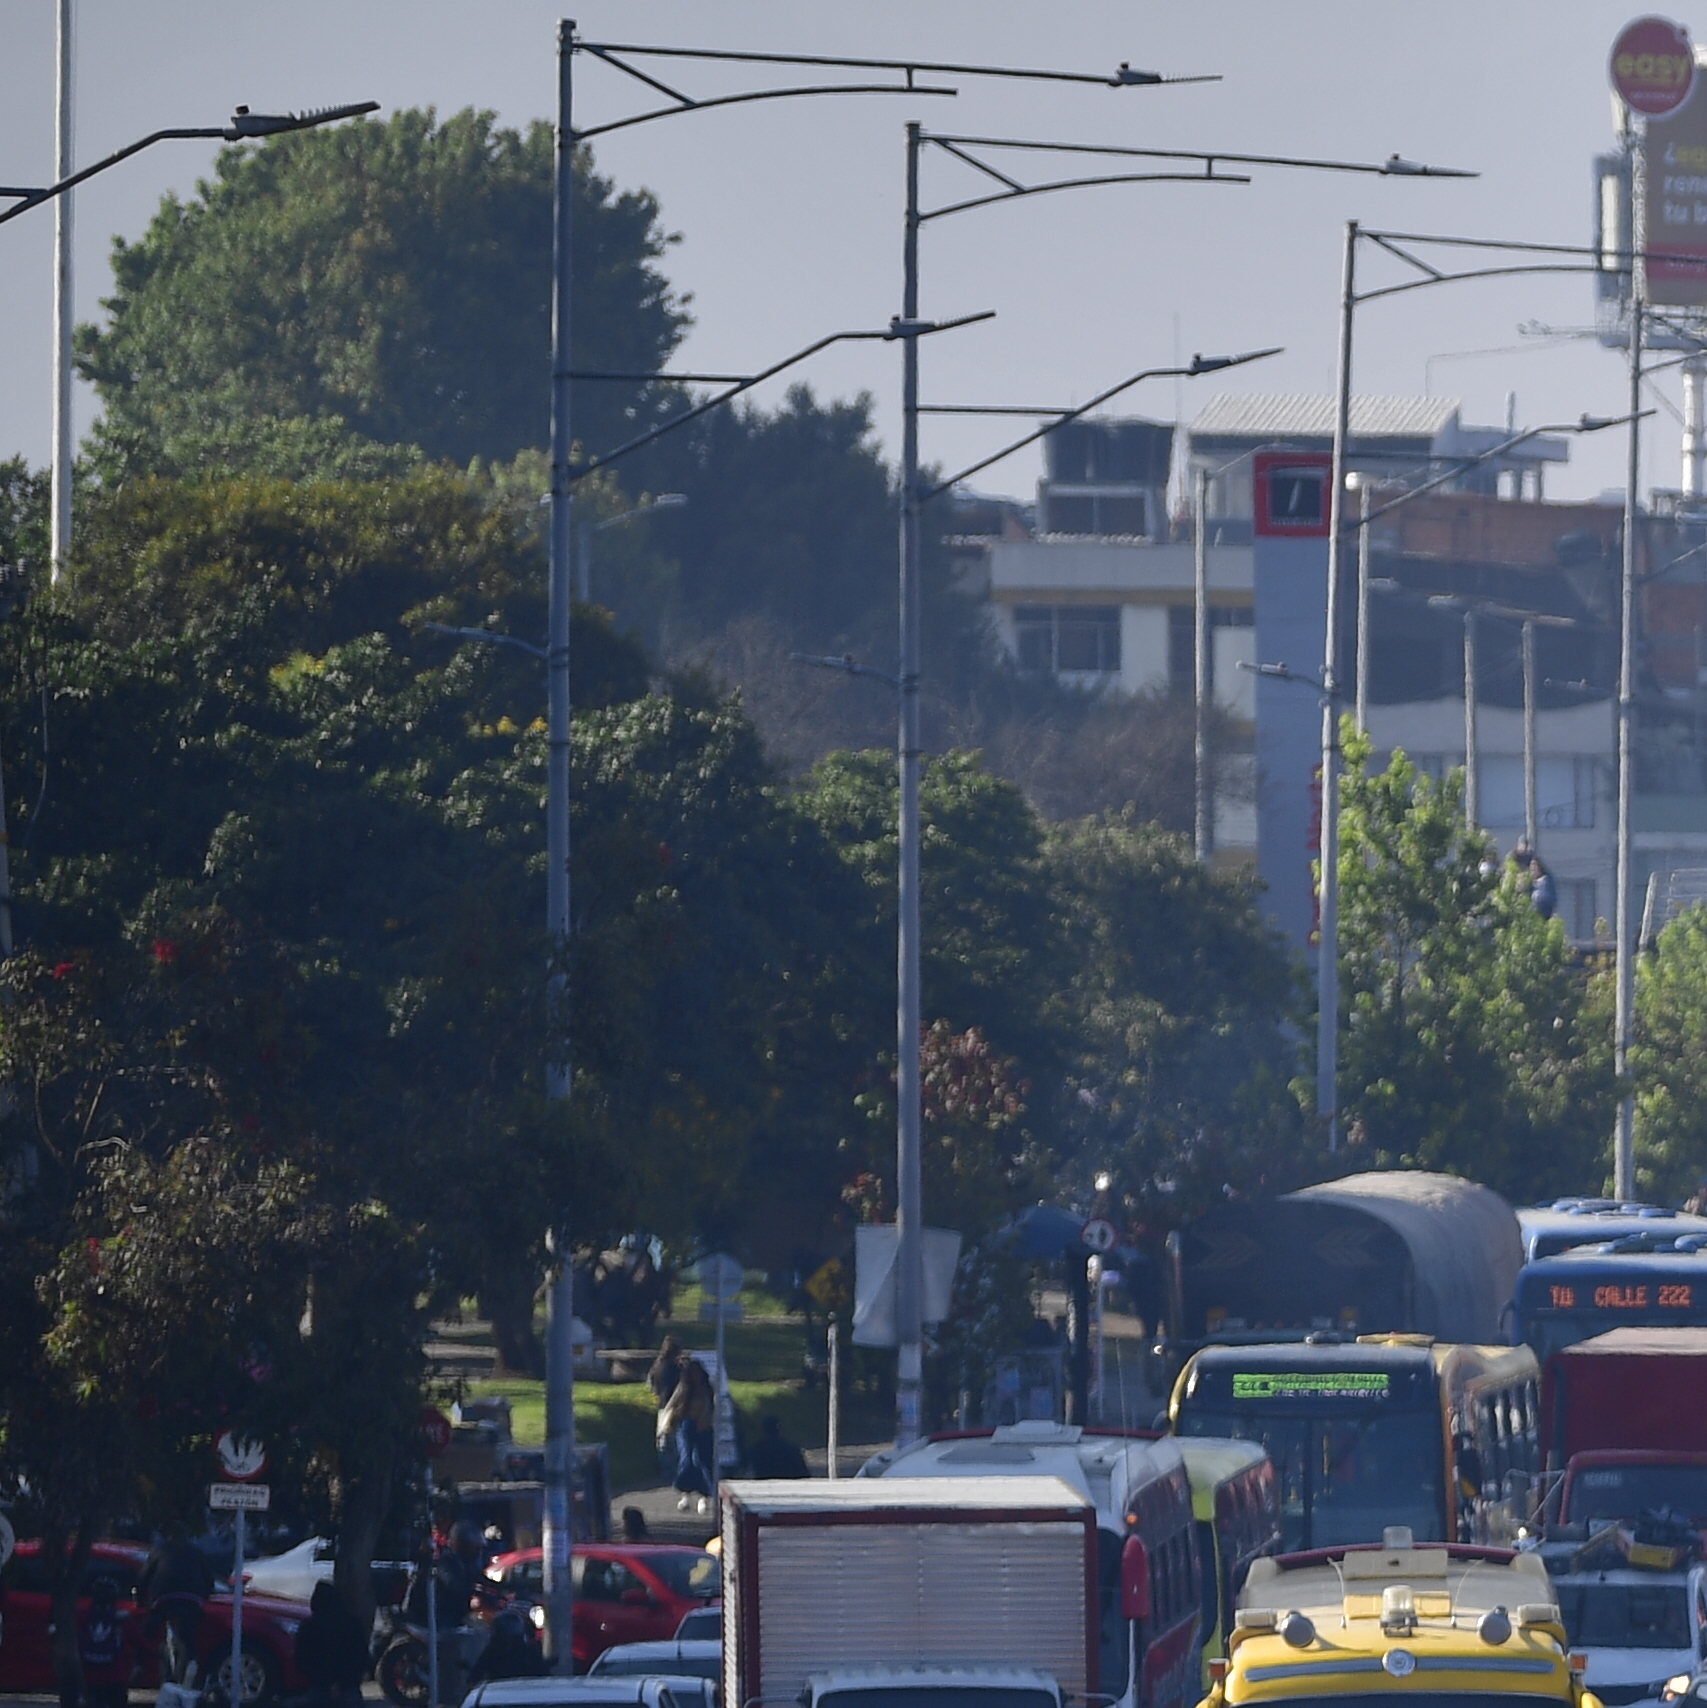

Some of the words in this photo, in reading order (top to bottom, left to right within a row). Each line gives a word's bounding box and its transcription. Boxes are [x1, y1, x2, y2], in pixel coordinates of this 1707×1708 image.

[1616, 53, 1690, 87] easy
[1664, 201, 1689, 224] tu
[1594, 1285, 1647, 1307] CALLE
[1658, 1285, 1692, 1307] 222
